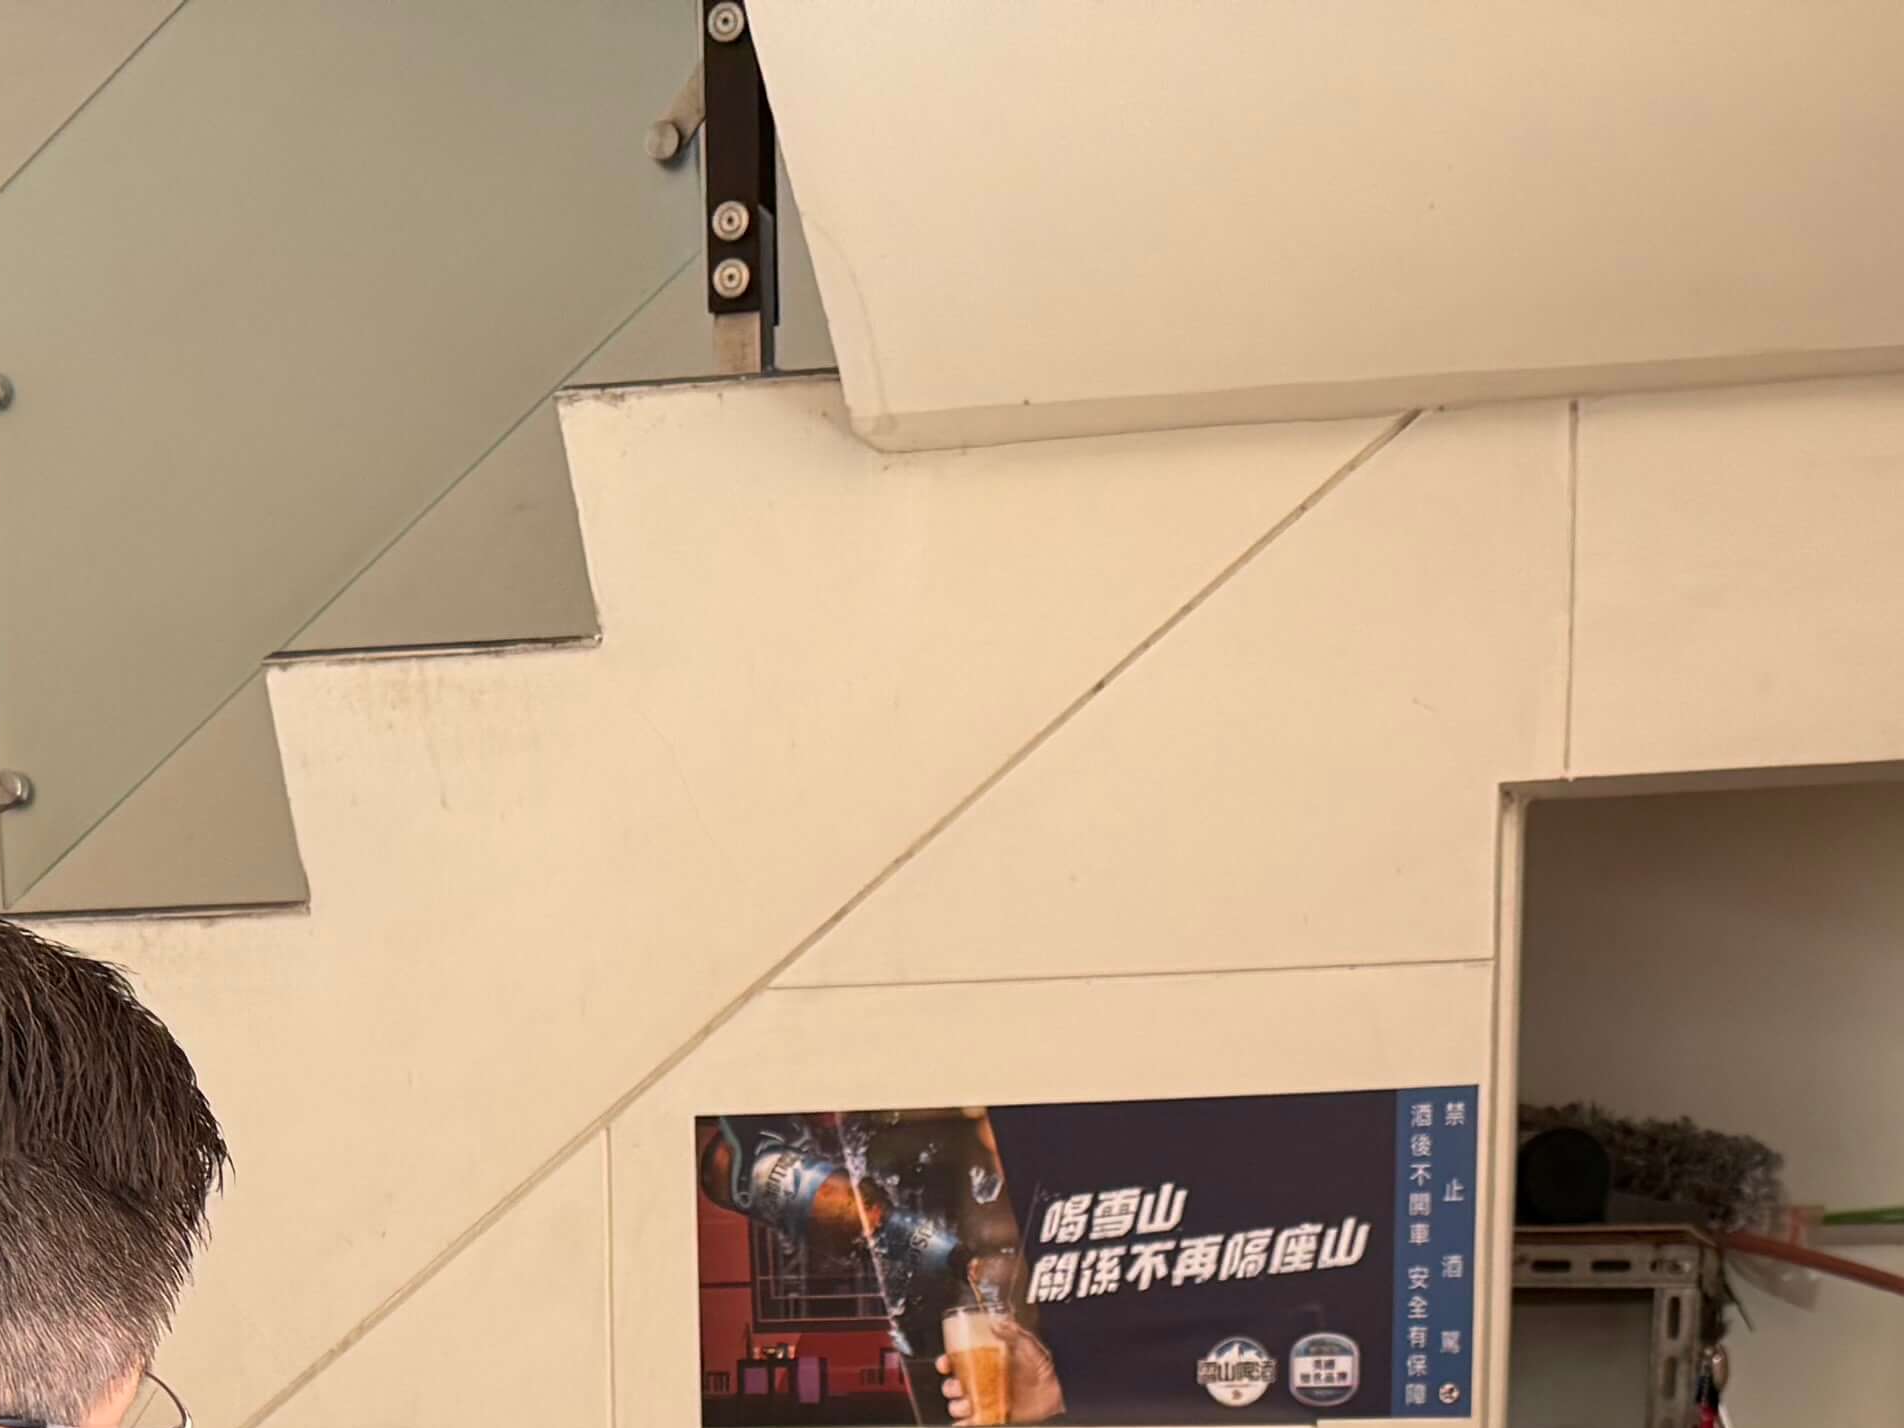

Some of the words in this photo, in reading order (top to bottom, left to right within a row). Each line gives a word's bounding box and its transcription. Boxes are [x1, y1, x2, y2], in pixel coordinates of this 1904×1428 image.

[1039, 1181, 1188, 1244] 喝雪山
[1408, 1103, 1433, 1246] 酒後不開車
[1026, 1216, 1372, 1304] 關係不再隔座山
[1404, 1266, 1430, 1406] 安全有保障
